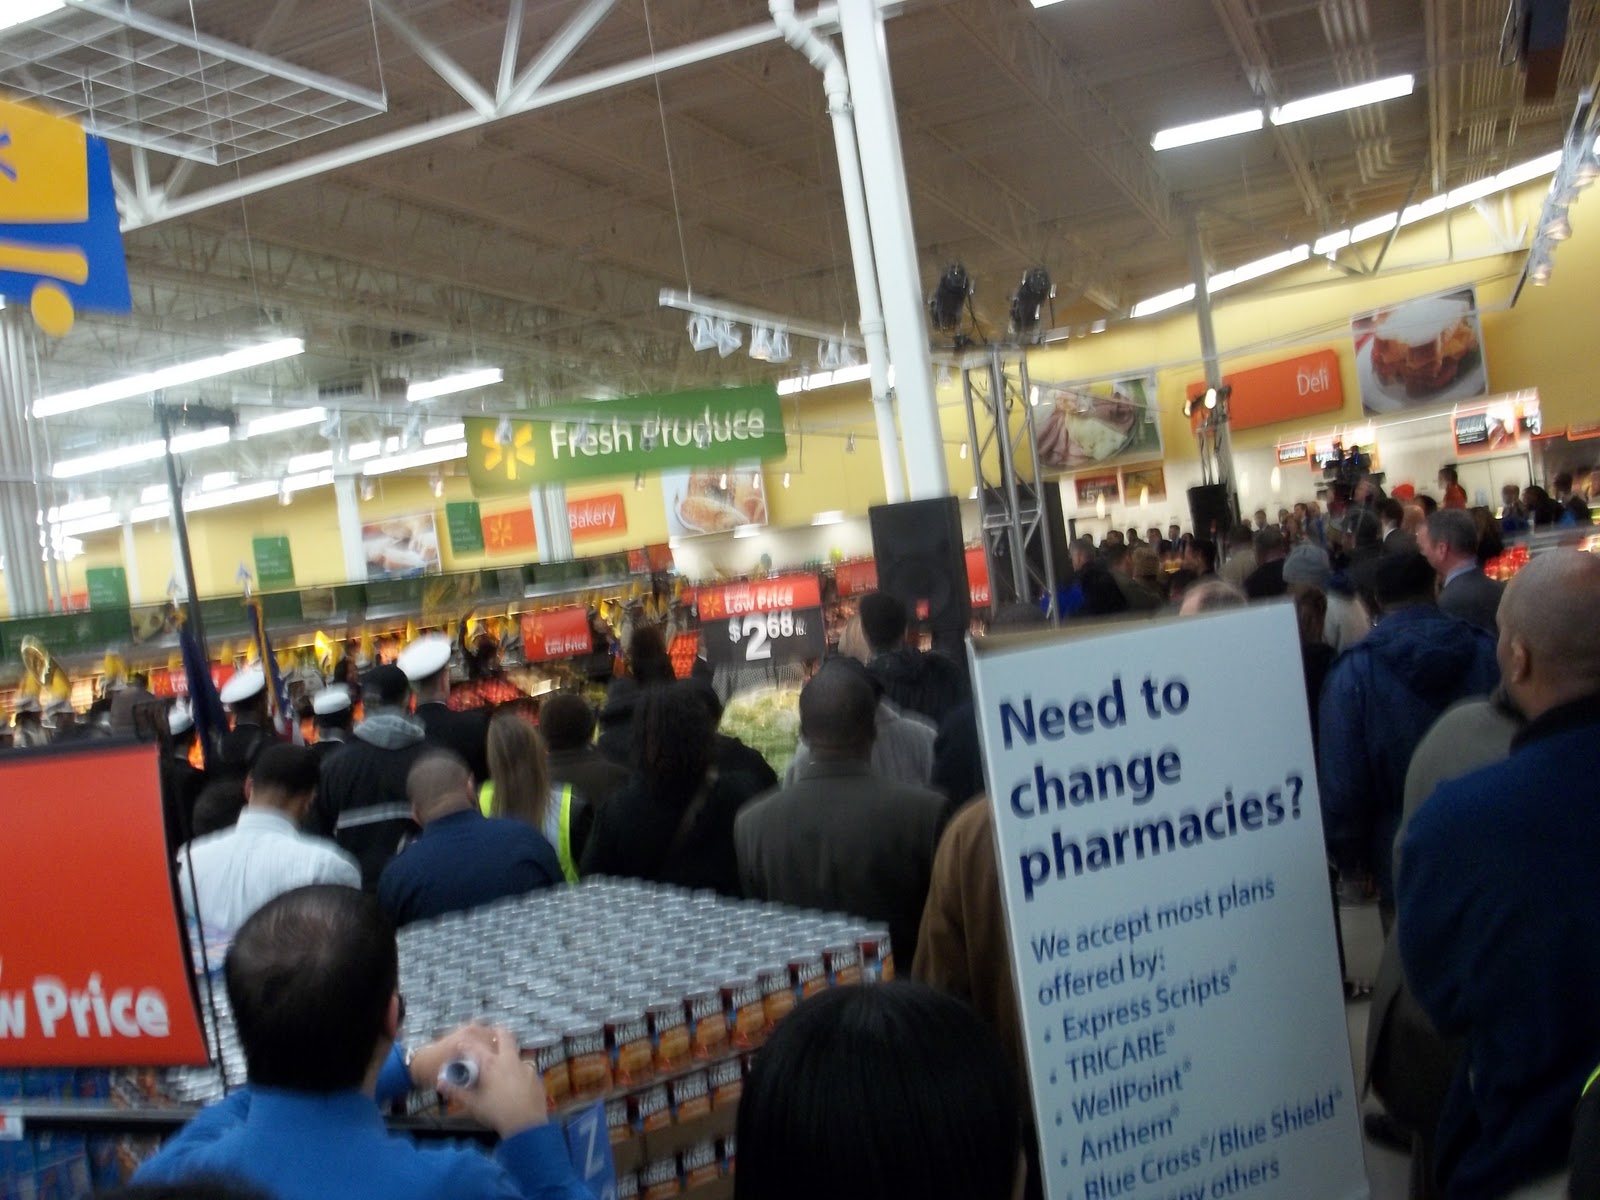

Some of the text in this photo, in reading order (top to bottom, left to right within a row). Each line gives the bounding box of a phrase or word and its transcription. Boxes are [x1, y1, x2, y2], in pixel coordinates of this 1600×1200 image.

[1296, 366, 1329, 396] Deli
[550, 405, 765, 459] Fresh Produce
[568, 502, 617, 530] Bakery
[724, 594, 755, 614] Low
[757, 585, 794, 610] Price
[545, 640, 563, 655] Low
[564, 634, 588, 652] Price
[999, 673, 1190, 750] Need to
[1009, 745, 1182, 820] change
[1019, 771, 1304, 902] pharmacies?
[1030, 878, 1276, 964] We accept most plans
[1037, 948, 1166, 1007] offered by:
[32, 970, 170, 1039] Price
[1062, 997, 1152, 1043] Express
[1083, 1172, 1136, 1200] Blue
[1211, 1157, 1280, 1196] others
